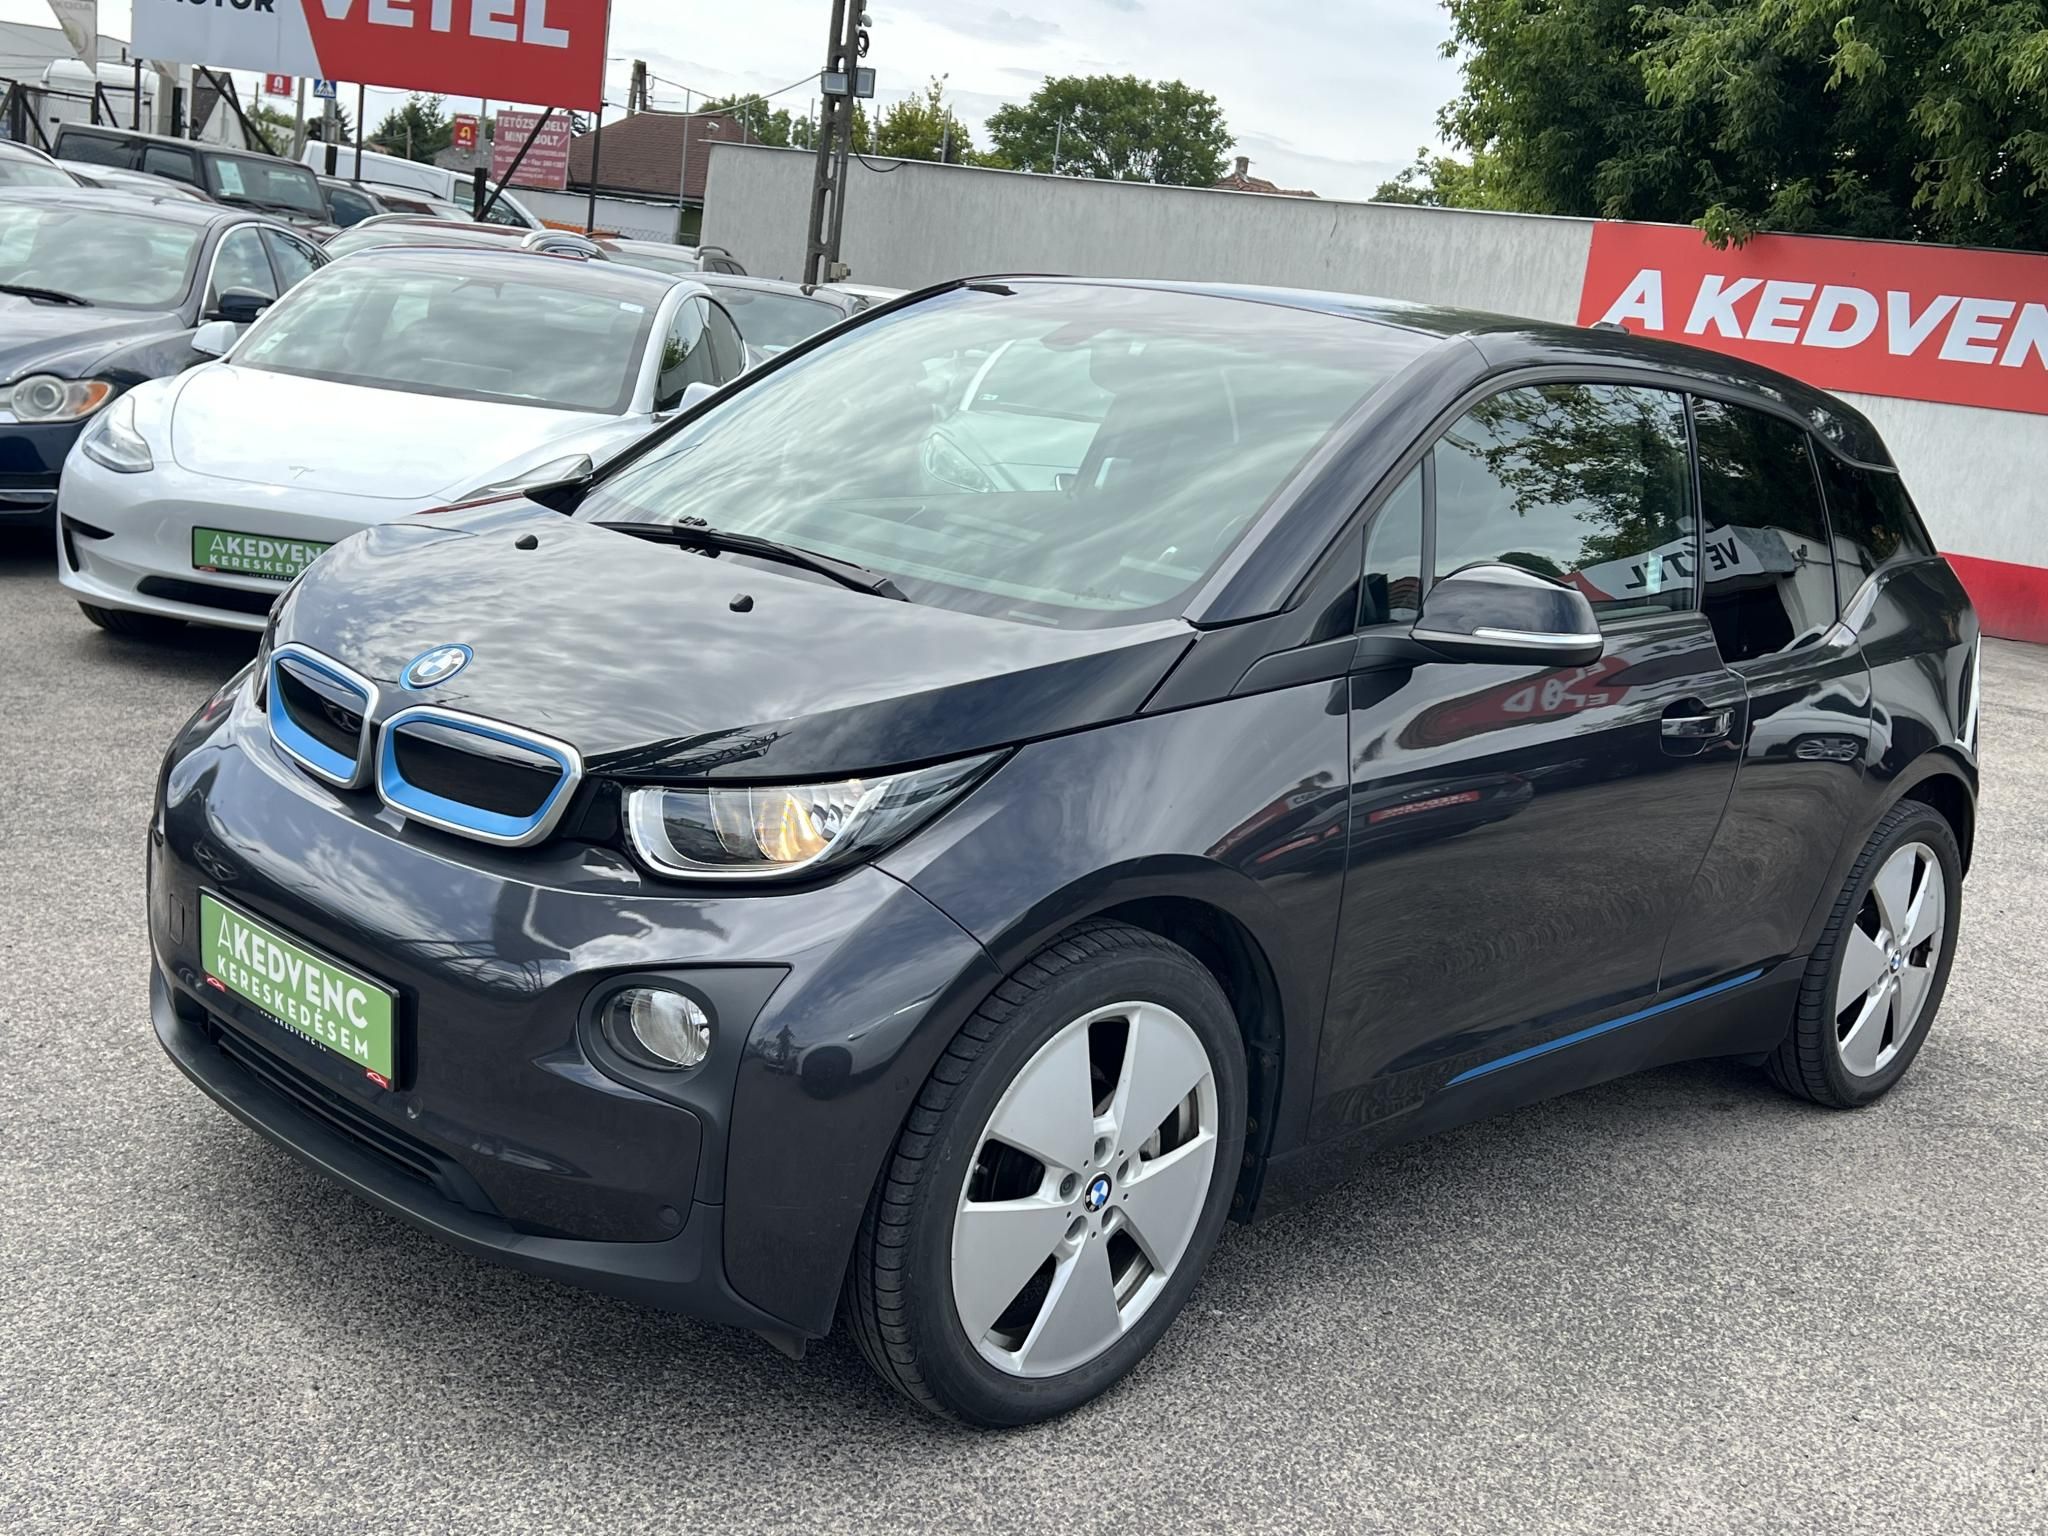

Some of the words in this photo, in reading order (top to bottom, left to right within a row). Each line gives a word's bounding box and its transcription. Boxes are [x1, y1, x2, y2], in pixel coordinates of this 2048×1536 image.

[504, 131, 559, 146] MINTBOLT
[1600, 269, 1664, 331] A
[217, 954, 369, 1060] KERESKEDÉSEM
